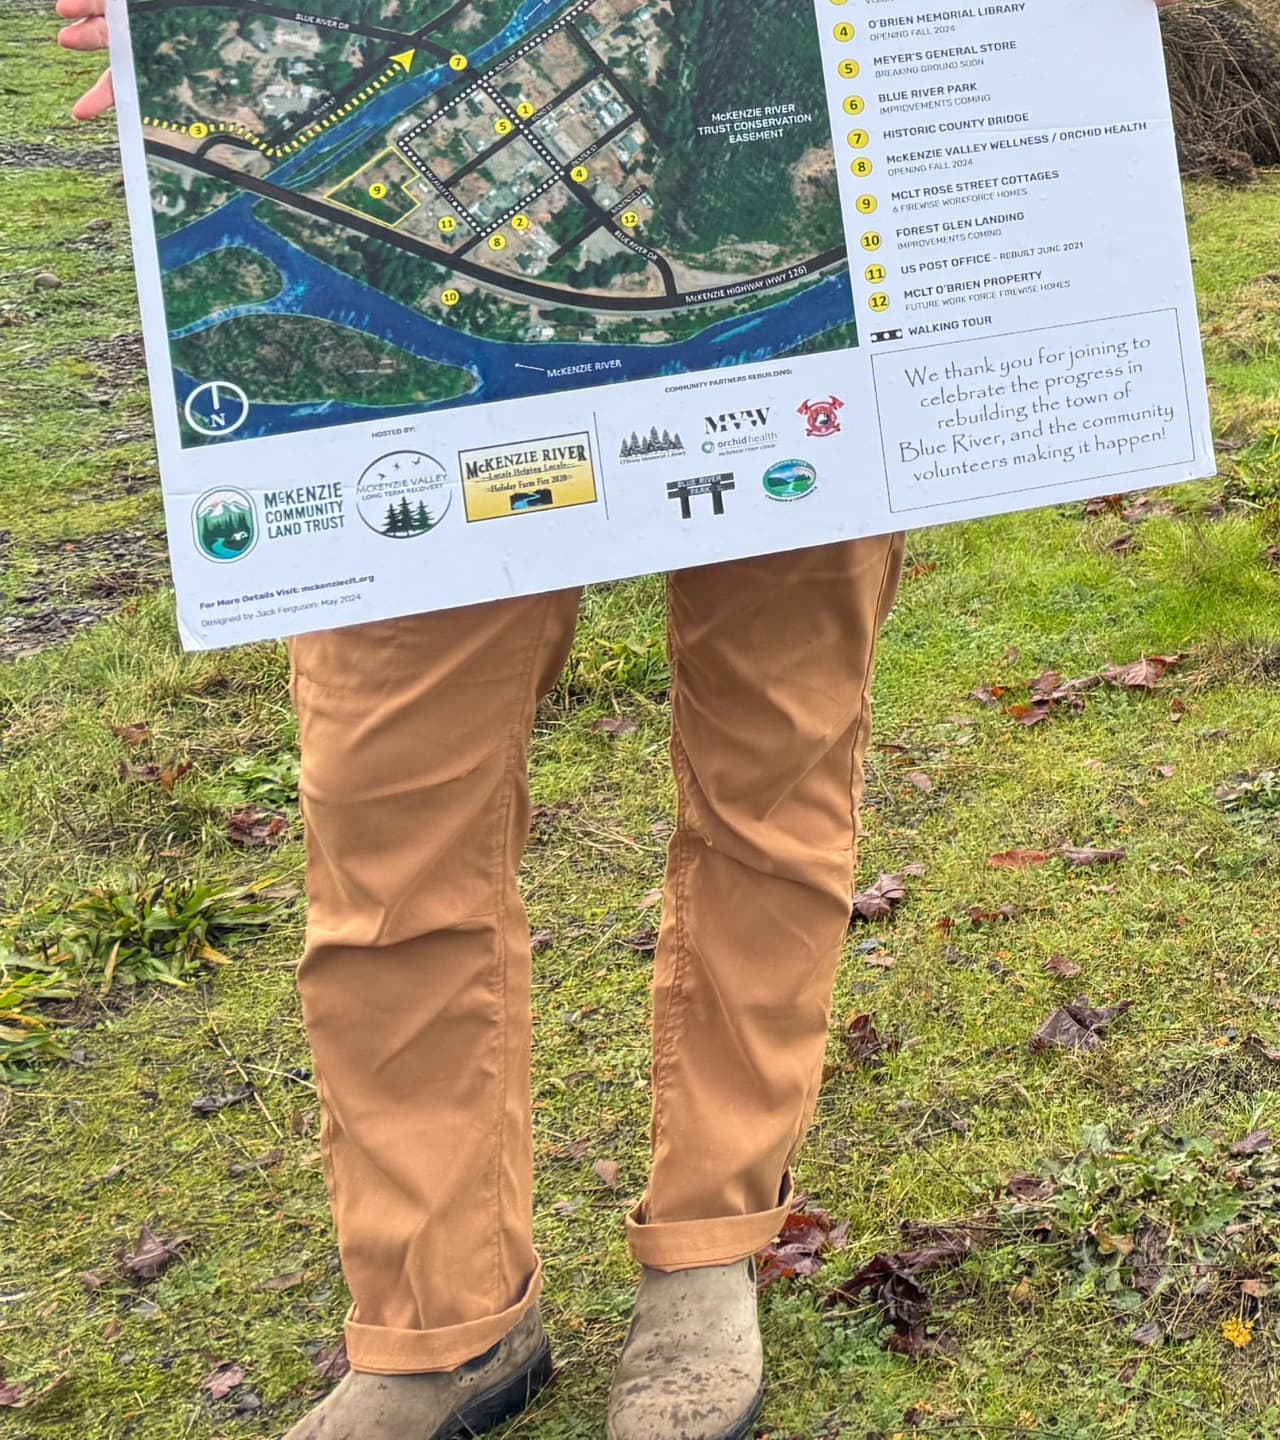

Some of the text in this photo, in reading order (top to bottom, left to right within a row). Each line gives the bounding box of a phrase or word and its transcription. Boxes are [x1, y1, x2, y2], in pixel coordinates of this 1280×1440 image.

[916, 8, 976, 23] MEMORIAL
[977, 2, 1025, 16] LIBRARY
[869, 24, 955, 41] OPENING FALL 2024
[873, 51, 922, 66] MEYER'S
[924, 45, 978, 59] GENERAL
[979, 40, 1016, 52] STORE
[874, 58, 984, 78] BREAKING GROUND SOON
[878, 90, 908, 102] BLUE
[910, 86, 944, 98] RIVER
[946, 82, 977, 93] PARK
[879, 93, 990, 114] IMPROVEMENTS COMING
[697, 113, 811, 135] TRUST CONSERVATION
[711, 103, 795, 121] McKENZIE RIVER
[728, 128, 783, 143] EASEMENT
[882, 124, 936, 139] HISTORIC
[938, 117, 984, 132] COUNTY
[987, 112, 1029, 126] BRIDGE
[886, 148, 942, 164] McKENZIE
[944, 142, 987, 156] VALLEY
[989, 134, 1048, 150] WELLNESS
[1059, 127, 1101, 141] ORCHID
[1104, 121, 1146, 134] HEALTH
[887, 158, 973, 176] OPENING FALL 2024
[890, 188, 920, 200] MCLT
[922, 184, 953, 196] ROSE
[955, 177, 998, 191] STREET
[1000, 169, 1059, 185] COTTAGES
[900, 199, 939, 212] FIREWISE
[941, 191, 994, 206] WORKFORCE
[996, 187, 1028, 197] HOMES
[895, 223, 940, 237] FOREST
[942, 218, 972, 230] GLEN
[974, 211, 1024, 226] LANDING
[897, 228, 1002, 250] IMPROVEMENTS COMING
[900, 264, 916, 274] US
[918, 259, 948, 272] POST
[950, 252, 991, 267] OFFICE
[999, 248, 1034, 260] REBUILT
[1036, 244, 1060, 254] JUNE
[1062, 241, 1083, 251] 2021
[685, 265, 808, 303] McKENZIE HIGHWAY (HWY 126)
[903, 286, 933, 299] MCLT
[983, 270, 1042, 287] PROPERTY
[908, 315, 992, 335] WALKING TOUR
[547, 359, 621, 377] McKENZIE RIVER
[904, 338, 1150, 388] We thank you for joining to
[920, 360, 1143, 407] celebrate the progress in
[938, 381, 1132, 429] rebuilding the town of
[900, 404, 1174, 462] Blue River, and the community
[466, 444, 587, 480] McKENZIE RIVER
[913, 427, 1166, 481] volunteers making it happen!
[410, 473, 448, 486] VALLEY
[263, 481, 342, 509] McKENZIE
[265, 499, 344, 524] COMMUNITY
[267, 514, 344, 539] LAND TRUST
[216, 597, 240, 606] More
[241, 591, 274, 602] Details
